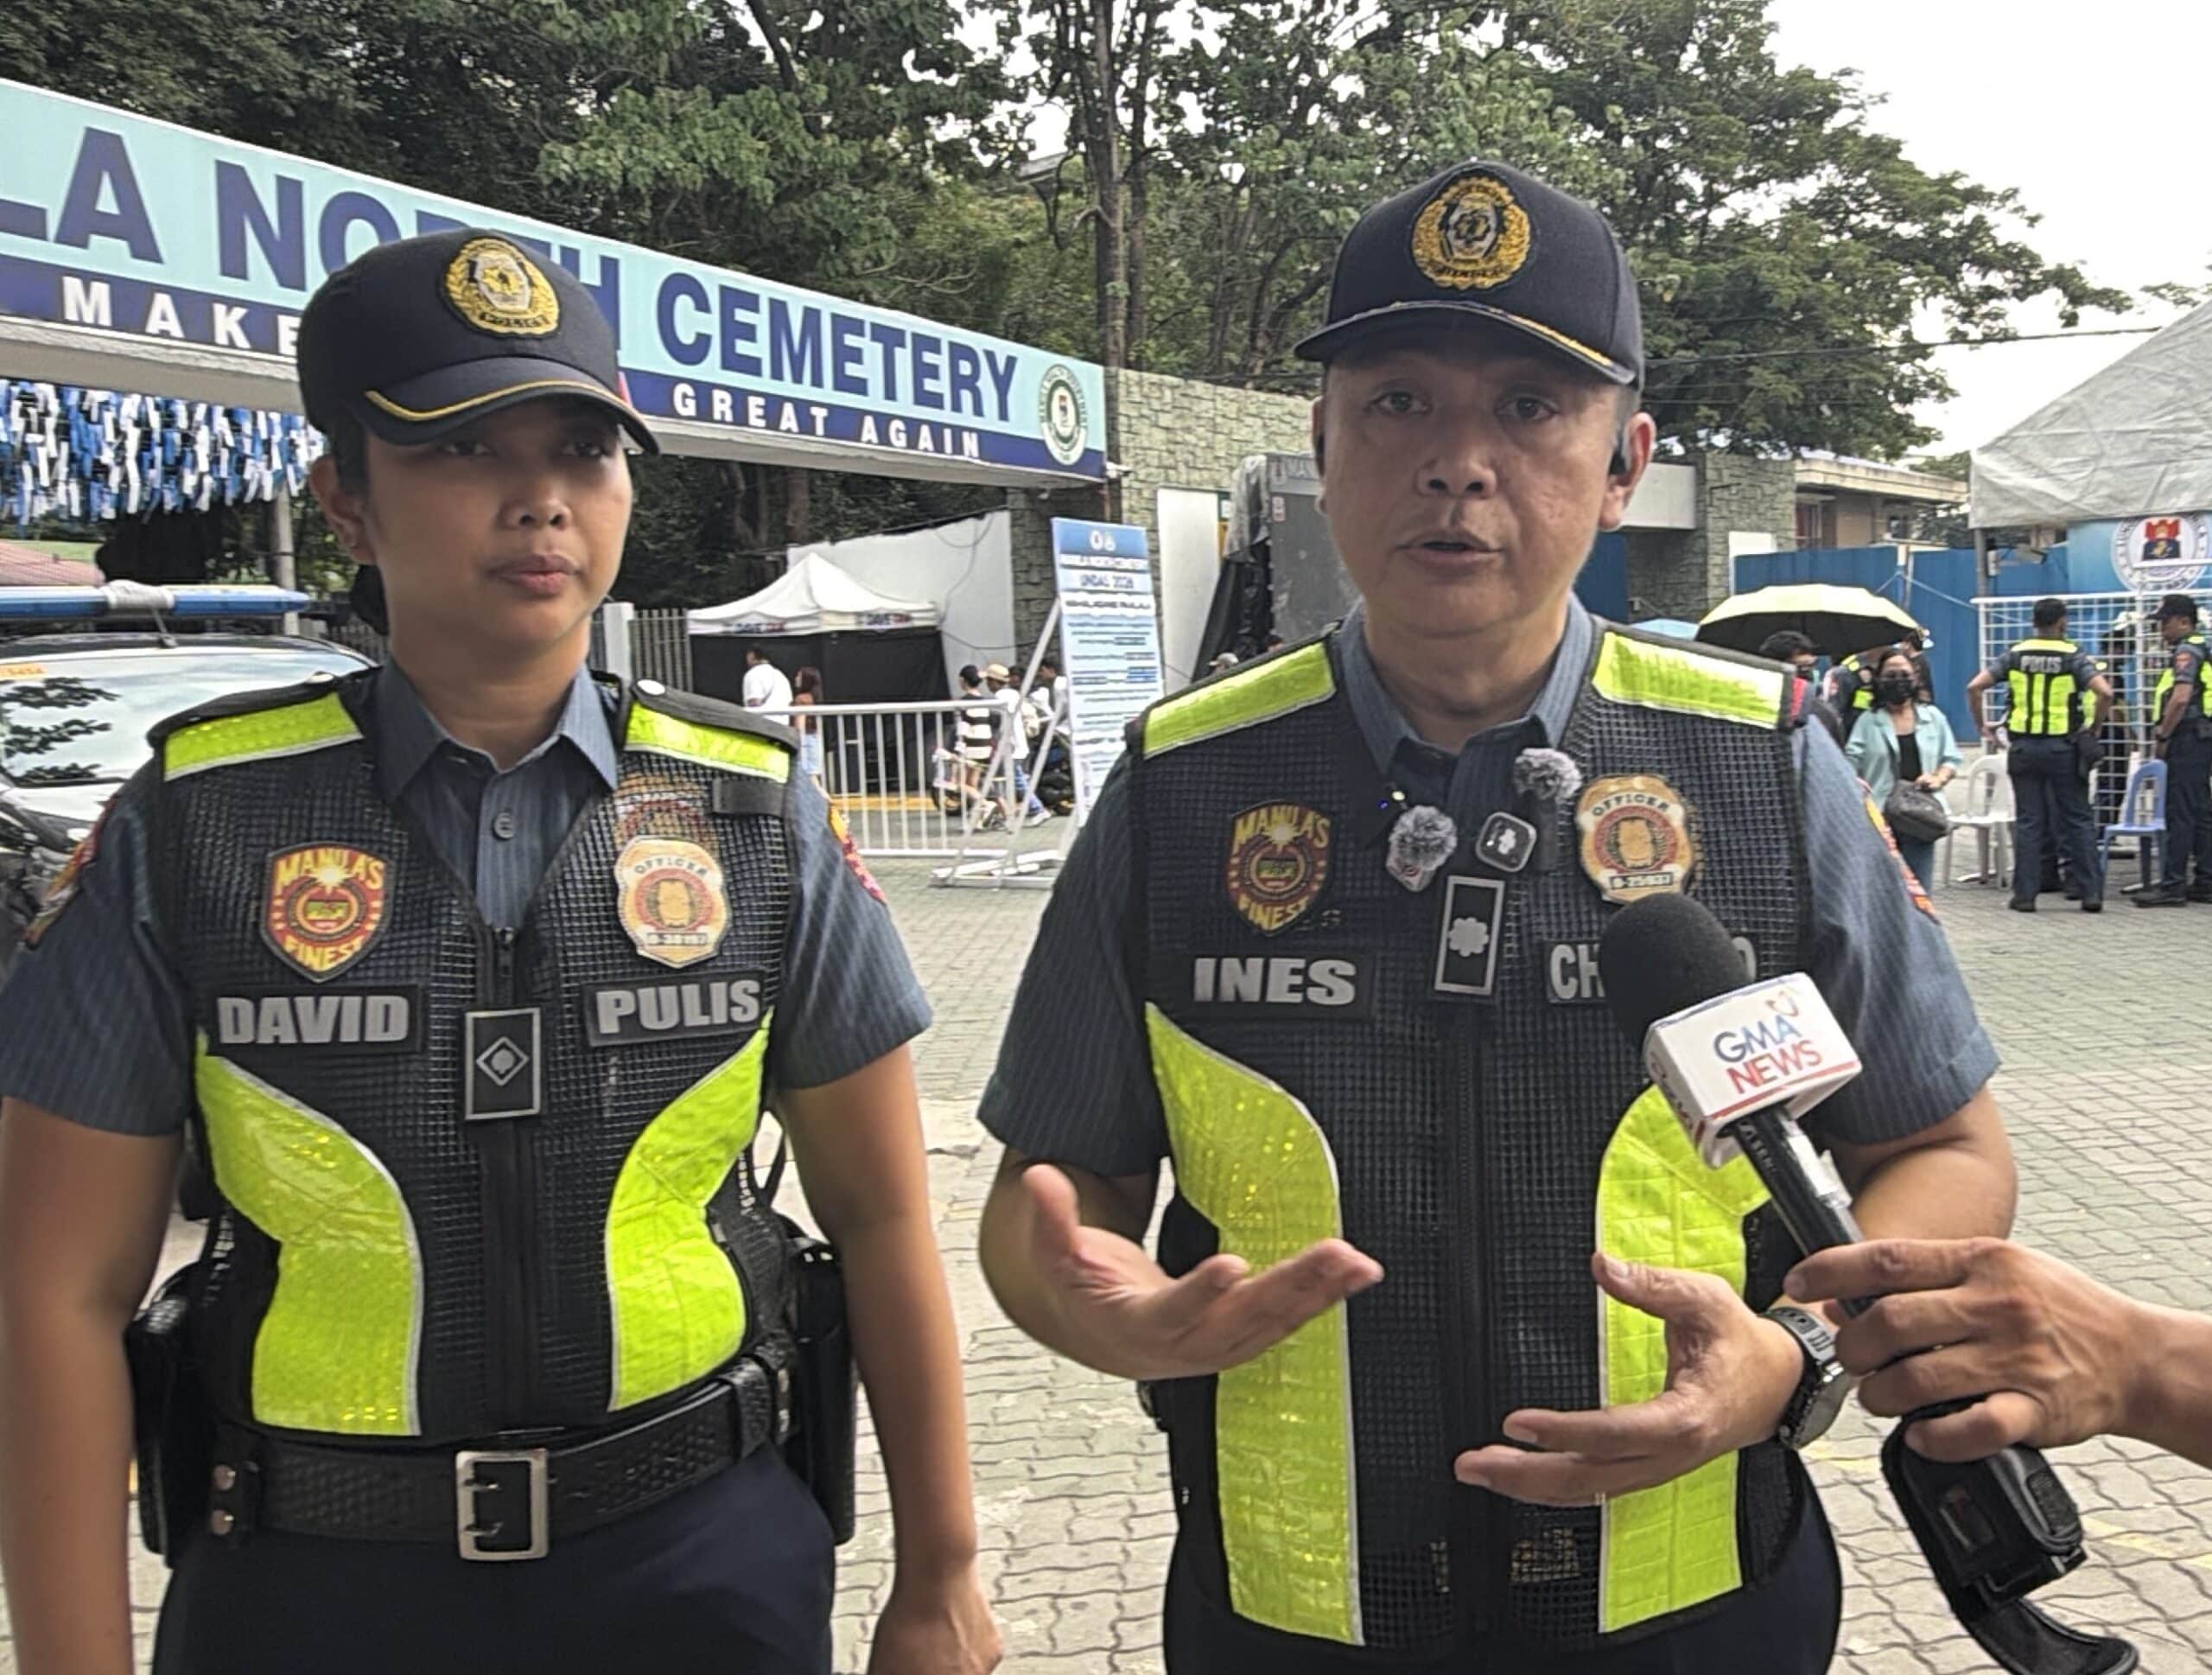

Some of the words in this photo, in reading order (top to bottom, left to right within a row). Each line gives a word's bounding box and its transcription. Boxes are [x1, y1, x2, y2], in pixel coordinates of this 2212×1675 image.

[214, 159, 621, 351] NOH
[656, 271, 1018, 422] CEMETERY
[672, 382, 830, 436] GREAT
[861, 413, 982, 458] AGAIN
[595, 979, 761, 1035] PULIS
[1193, 957, 1357, 1006] INES
[217, 996, 410, 1045] DAVID
[1713, 1013, 1802, 1063] GMA
[1726, 1039, 1823, 1095] NEWS
